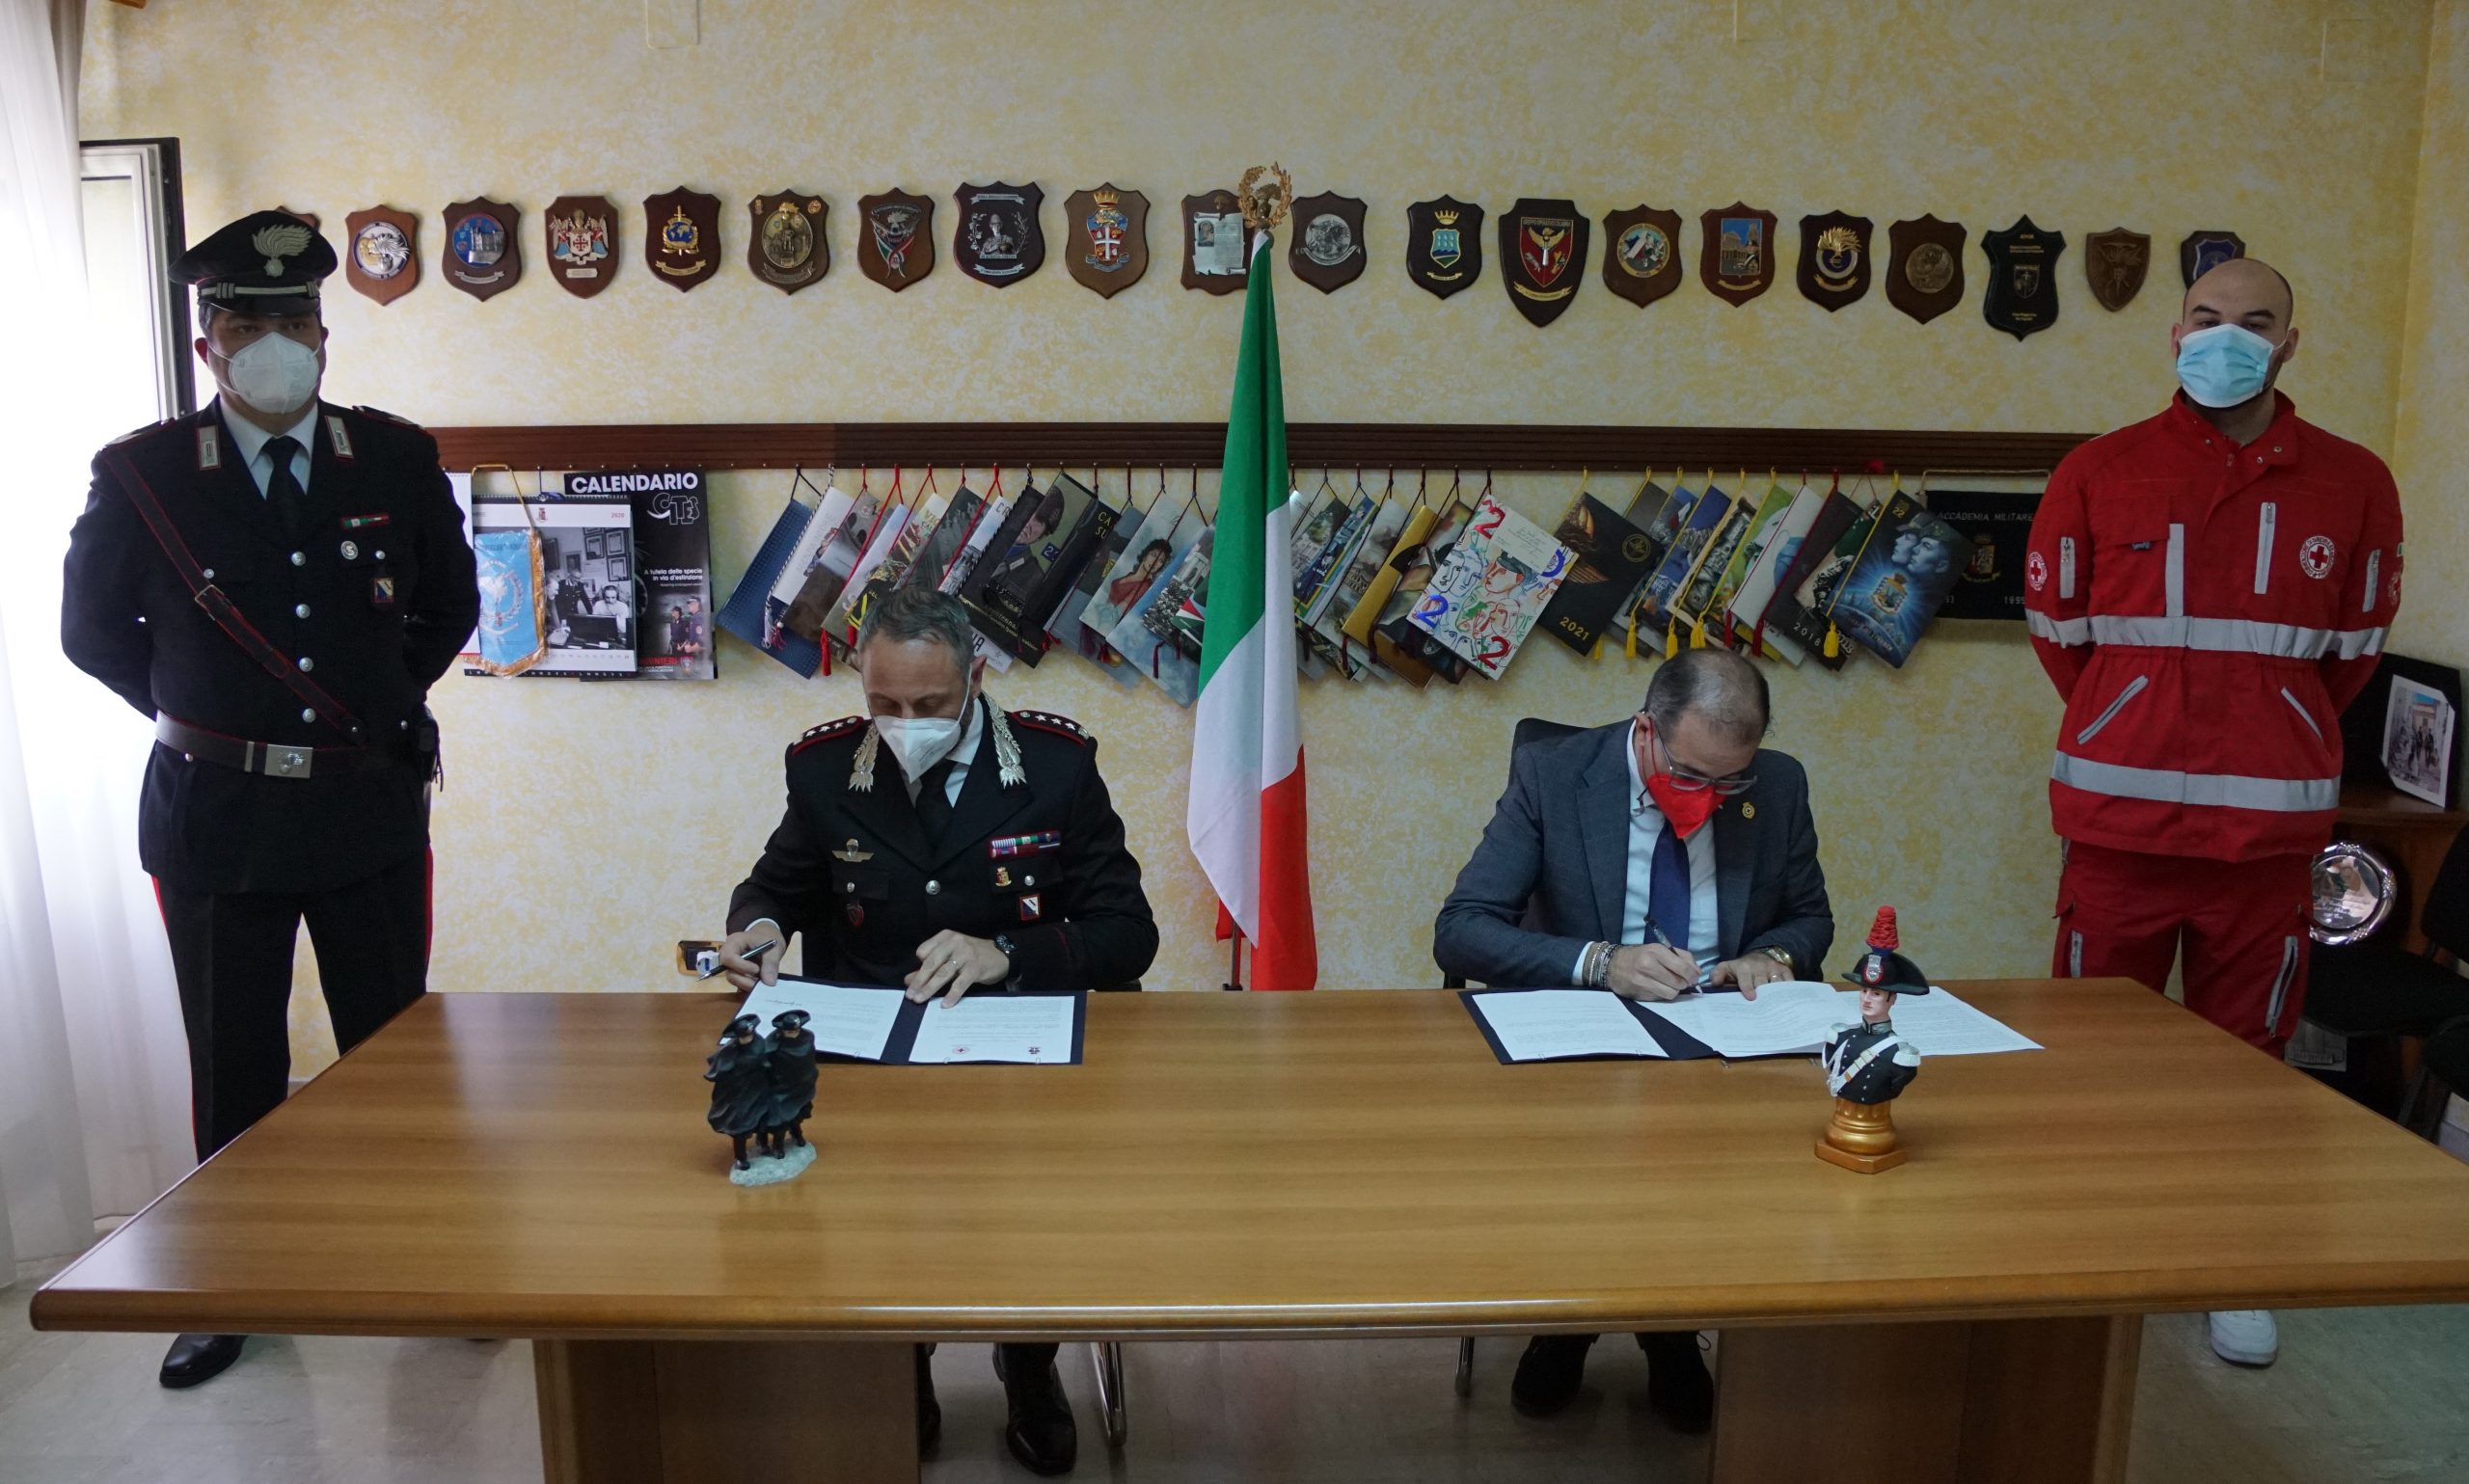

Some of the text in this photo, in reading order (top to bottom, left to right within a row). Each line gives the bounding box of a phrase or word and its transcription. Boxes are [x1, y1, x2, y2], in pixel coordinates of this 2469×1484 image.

[571, 472, 698, 494] CALENDARIO
[1937, 511, 1990, 521] ACCADEMIA
[684, 568, 703, 577] specie
[1560, 616, 1589, 641] 2021
[1793, 622, 1821, 646] 2018
